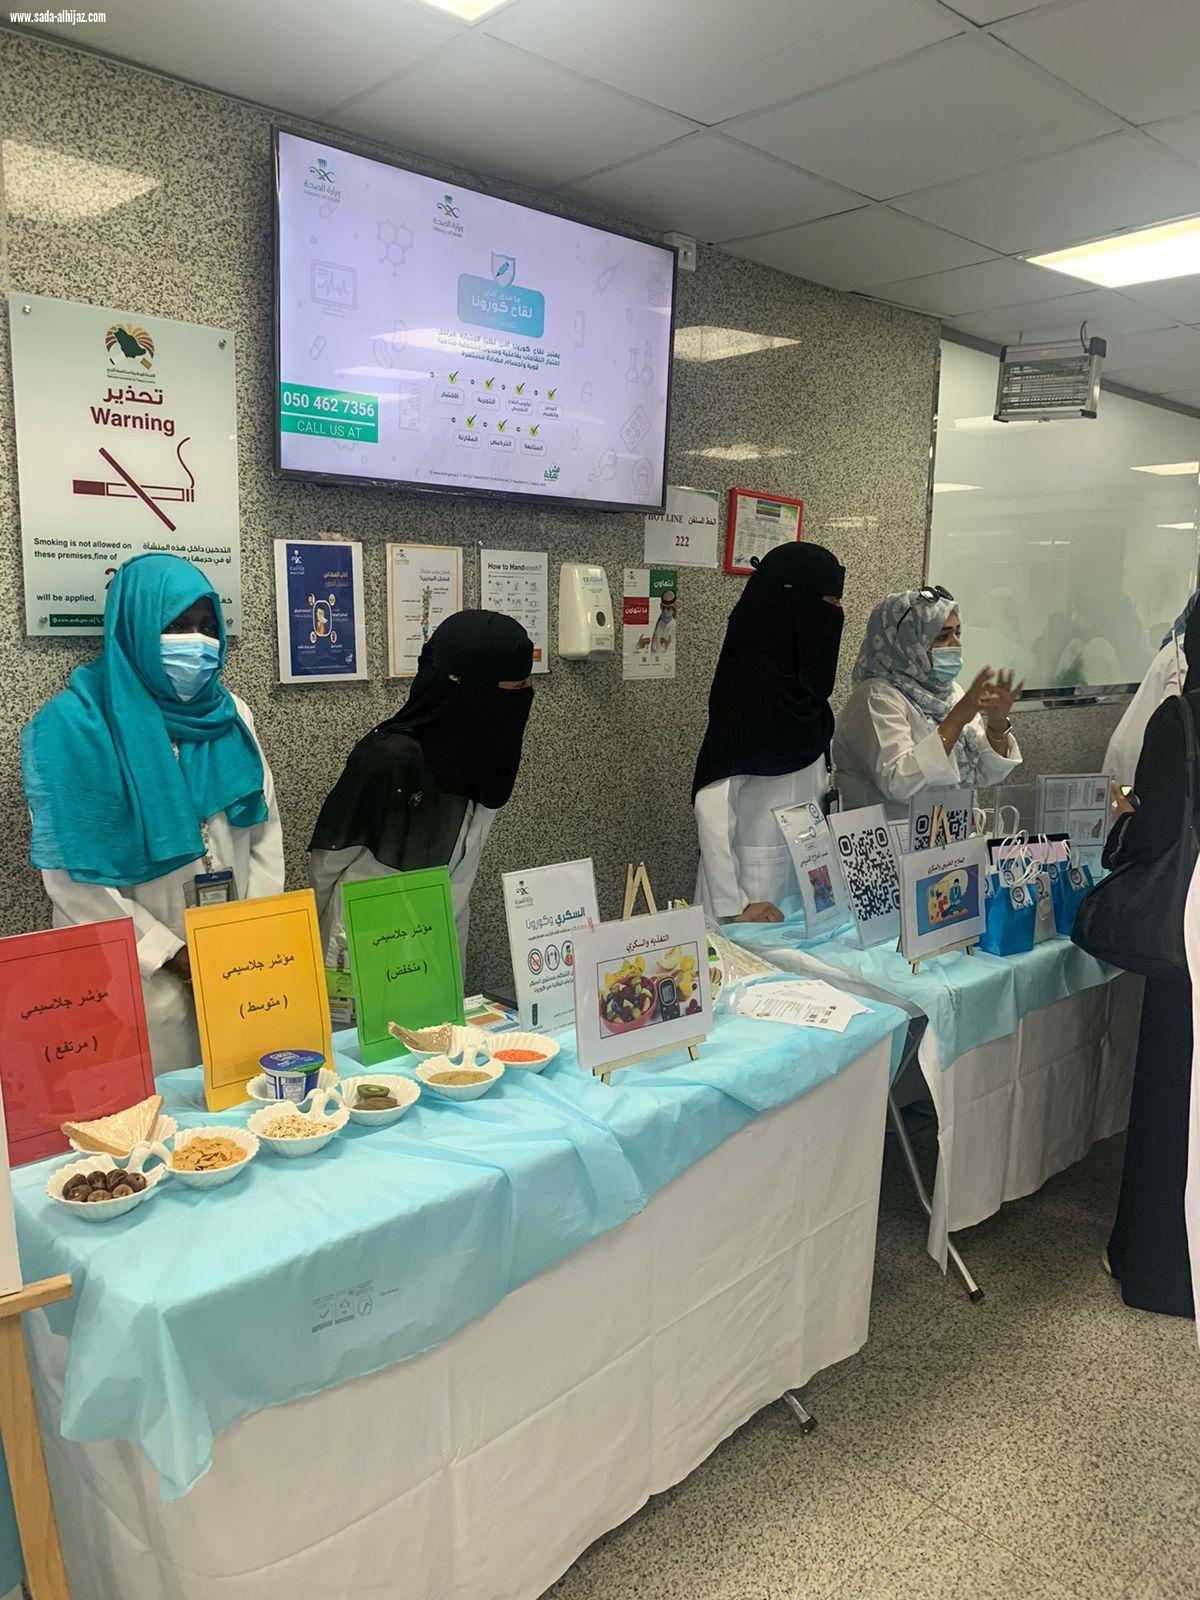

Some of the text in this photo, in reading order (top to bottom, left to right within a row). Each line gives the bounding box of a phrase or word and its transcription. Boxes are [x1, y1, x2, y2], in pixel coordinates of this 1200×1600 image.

[472, 294, 533, 318] لقاح كورونا
[512, 343, 531, 352] كورونا
[103, 385, 163, 405] تحذير
[283, 391, 376, 417] 050 462 7356
[90, 406, 175, 437] Warning
[297, 420, 362, 439] CALL US AT
[648, 513, 684, 524] HOT LINE
[34, 537, 68, 549] Smoking
[69, 539, 77, 548] is
[78, 540, 91, 548] not
[92, 540, 121, 549] allowed
[142, 541, 231, 554] التدخين داخل هذه المنشأة
[675, 535, 690, 547] 222
[34, 550, 57, 559] these
[213, 557, 225, 565] في
[653, 580, 674, 588] نتعاون
[36, 593, 97, 603] will be applied.
[525, 907, 586, 931] السكري وكورونا
[373, 924, 433, 946] مؤشر جلاسيمي
[222, 953, 295, 980] مؤشر جلاسيمي
[20, 989, 109, 1020] مؤشر جلاسيمي
